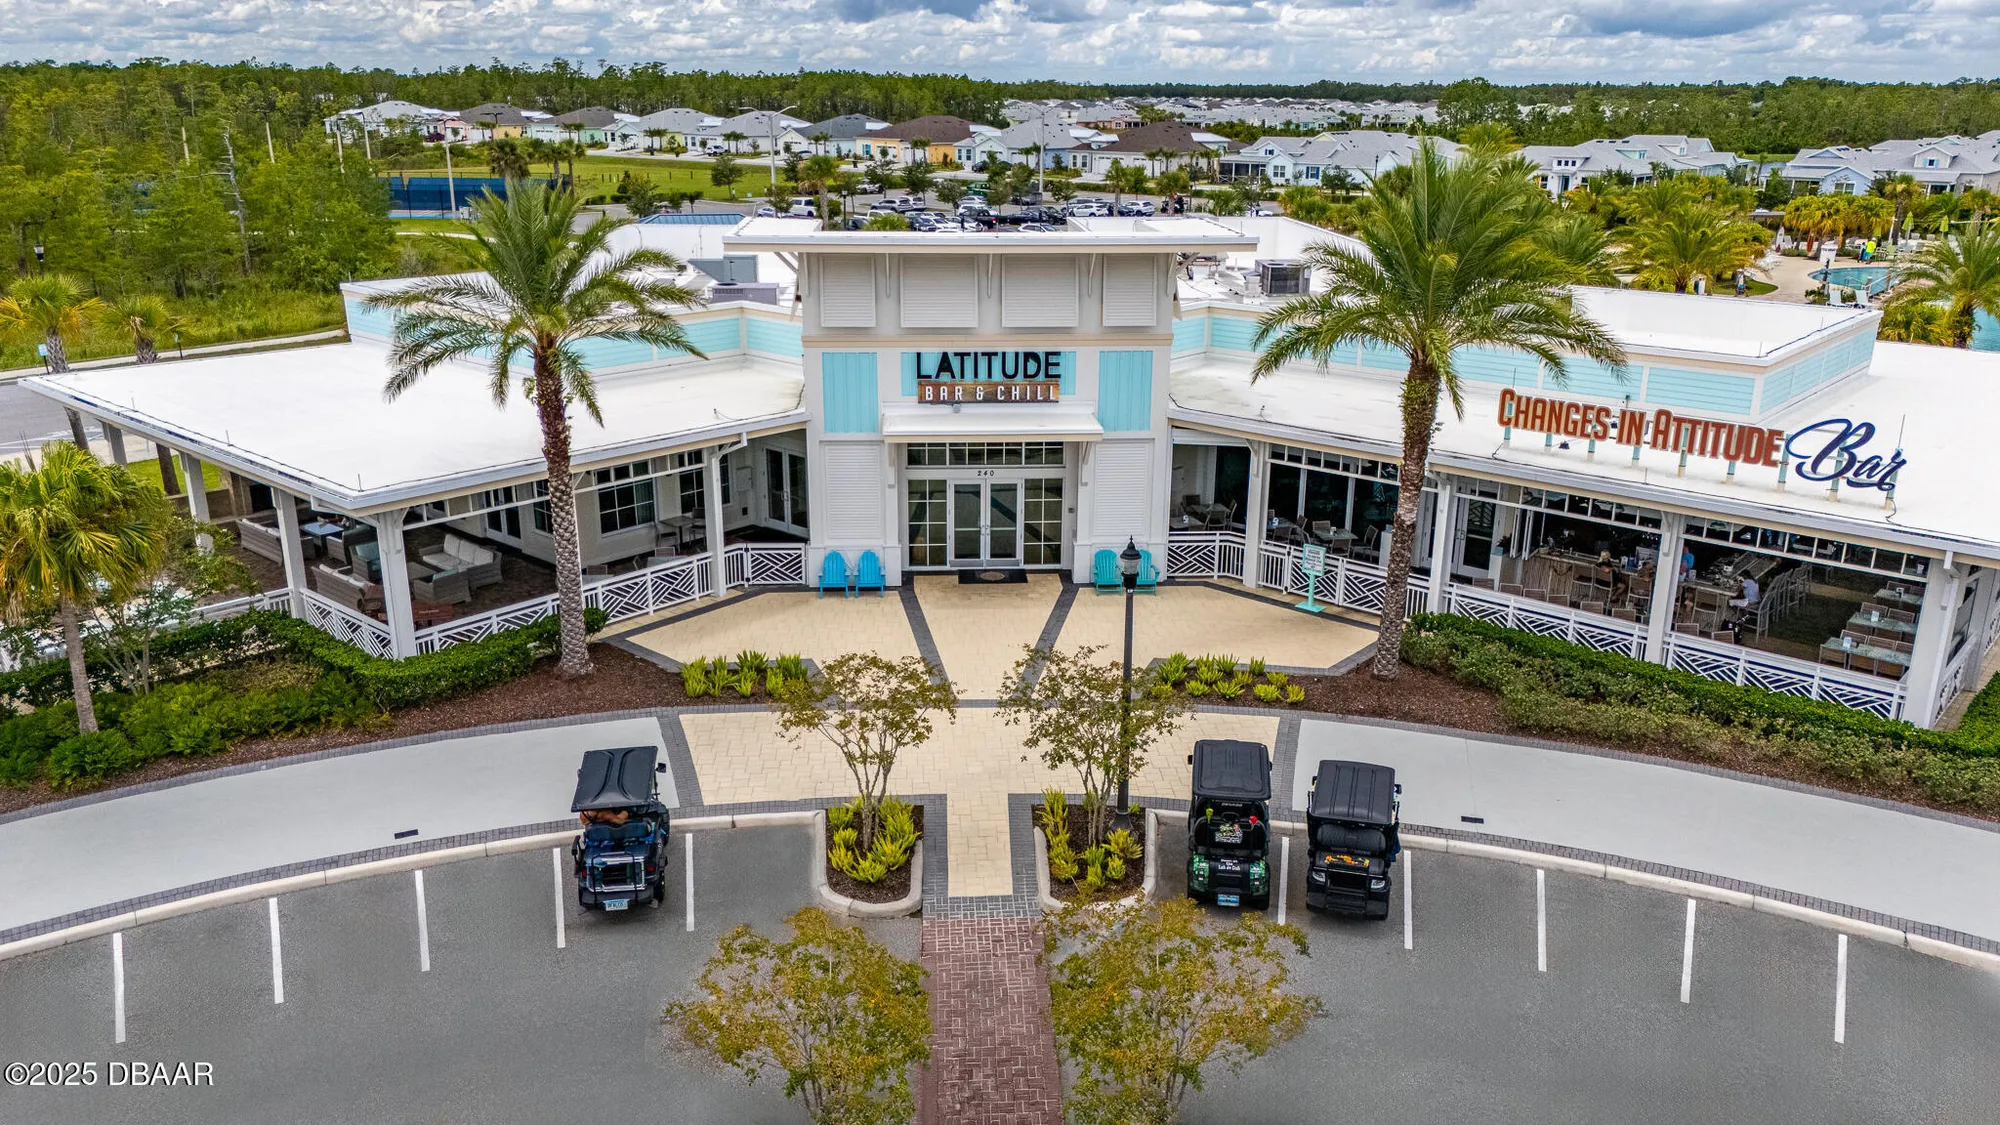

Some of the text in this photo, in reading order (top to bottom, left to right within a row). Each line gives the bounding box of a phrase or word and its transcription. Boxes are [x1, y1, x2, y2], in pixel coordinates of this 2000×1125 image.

[916, 351, 1062, 380] LATITUDE
[925, 386, 1055, 400] BAR & CHILL
[1497, 388, 1907, 491] CHANGES IN ATTITUDE Bar
